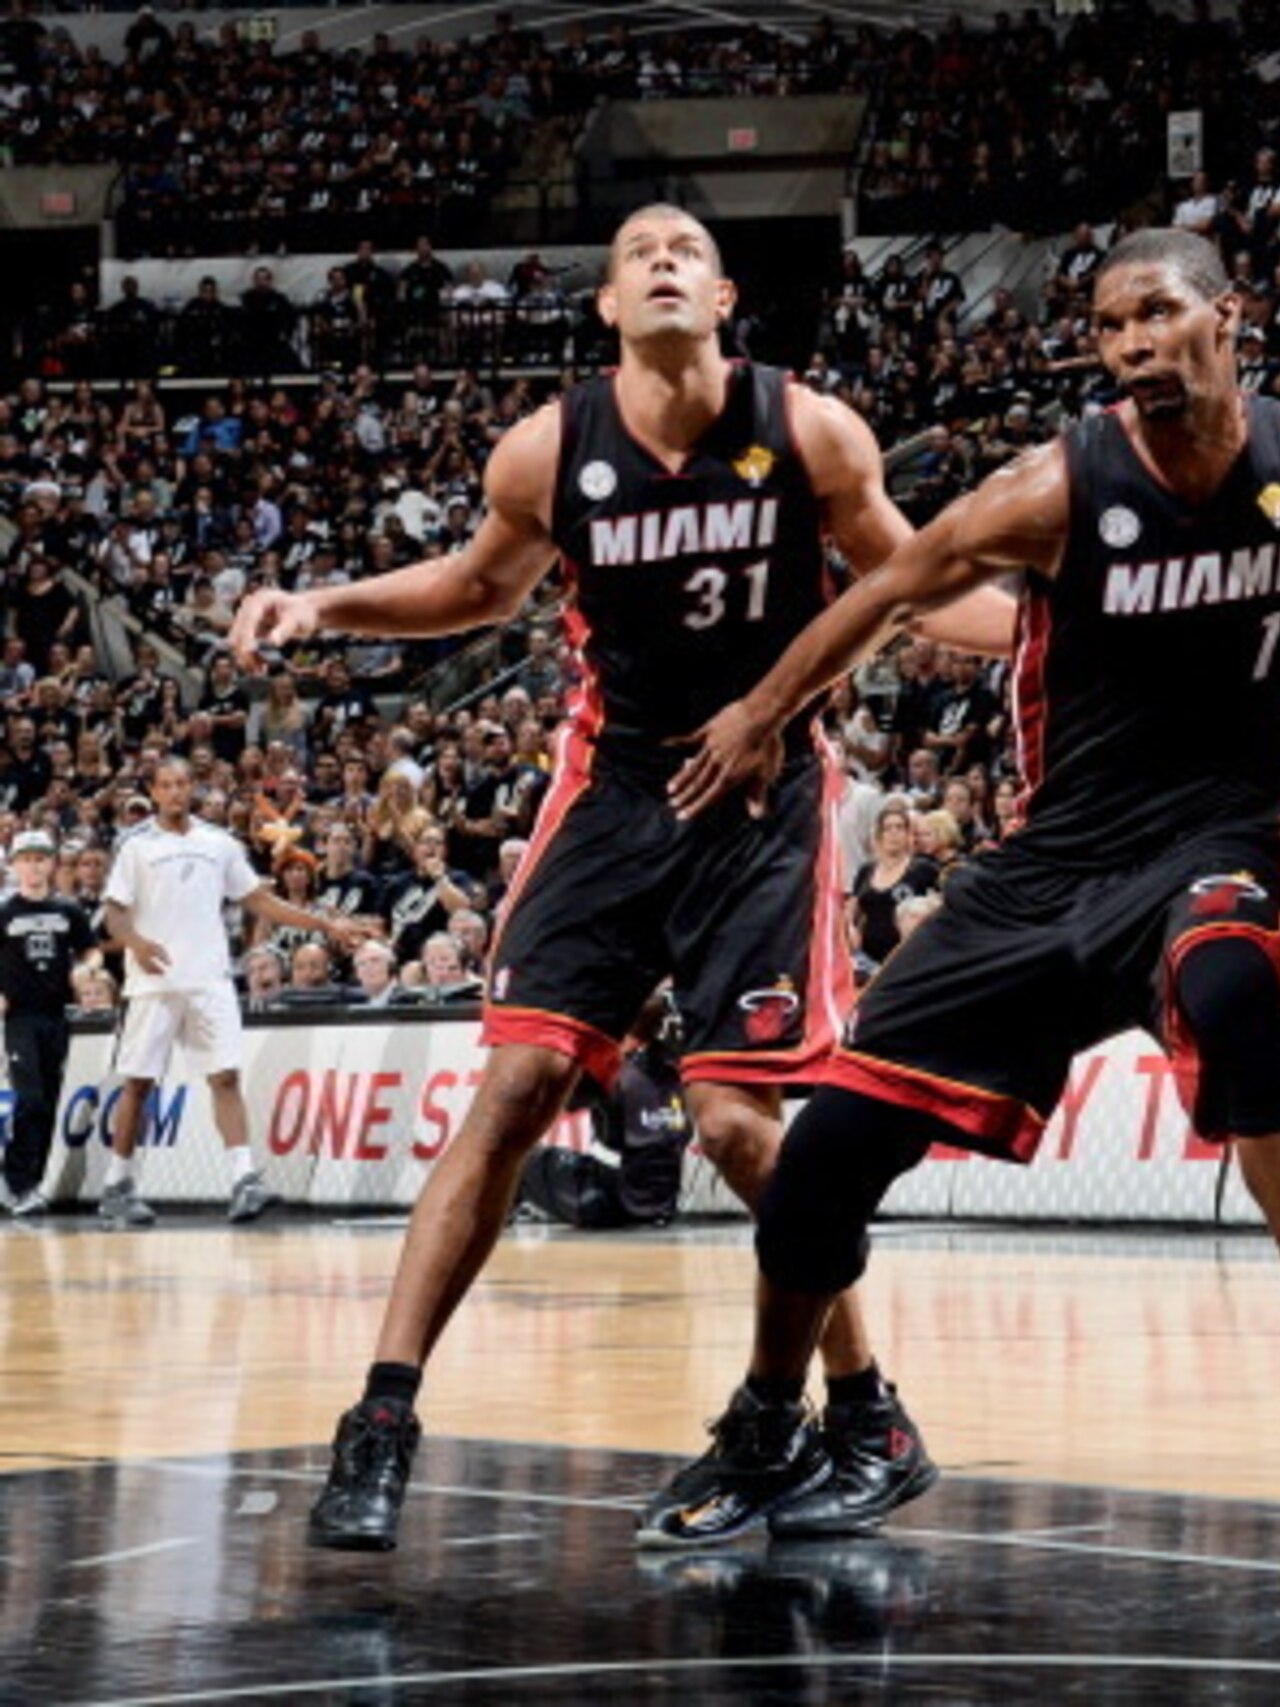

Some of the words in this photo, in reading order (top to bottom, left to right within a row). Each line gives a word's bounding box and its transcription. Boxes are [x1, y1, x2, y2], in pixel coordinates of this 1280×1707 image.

[590, 498, 778, 566] MIAMI
[683, 559, 769, 630] 31
[268, 1069, 402, 1160] ONE
